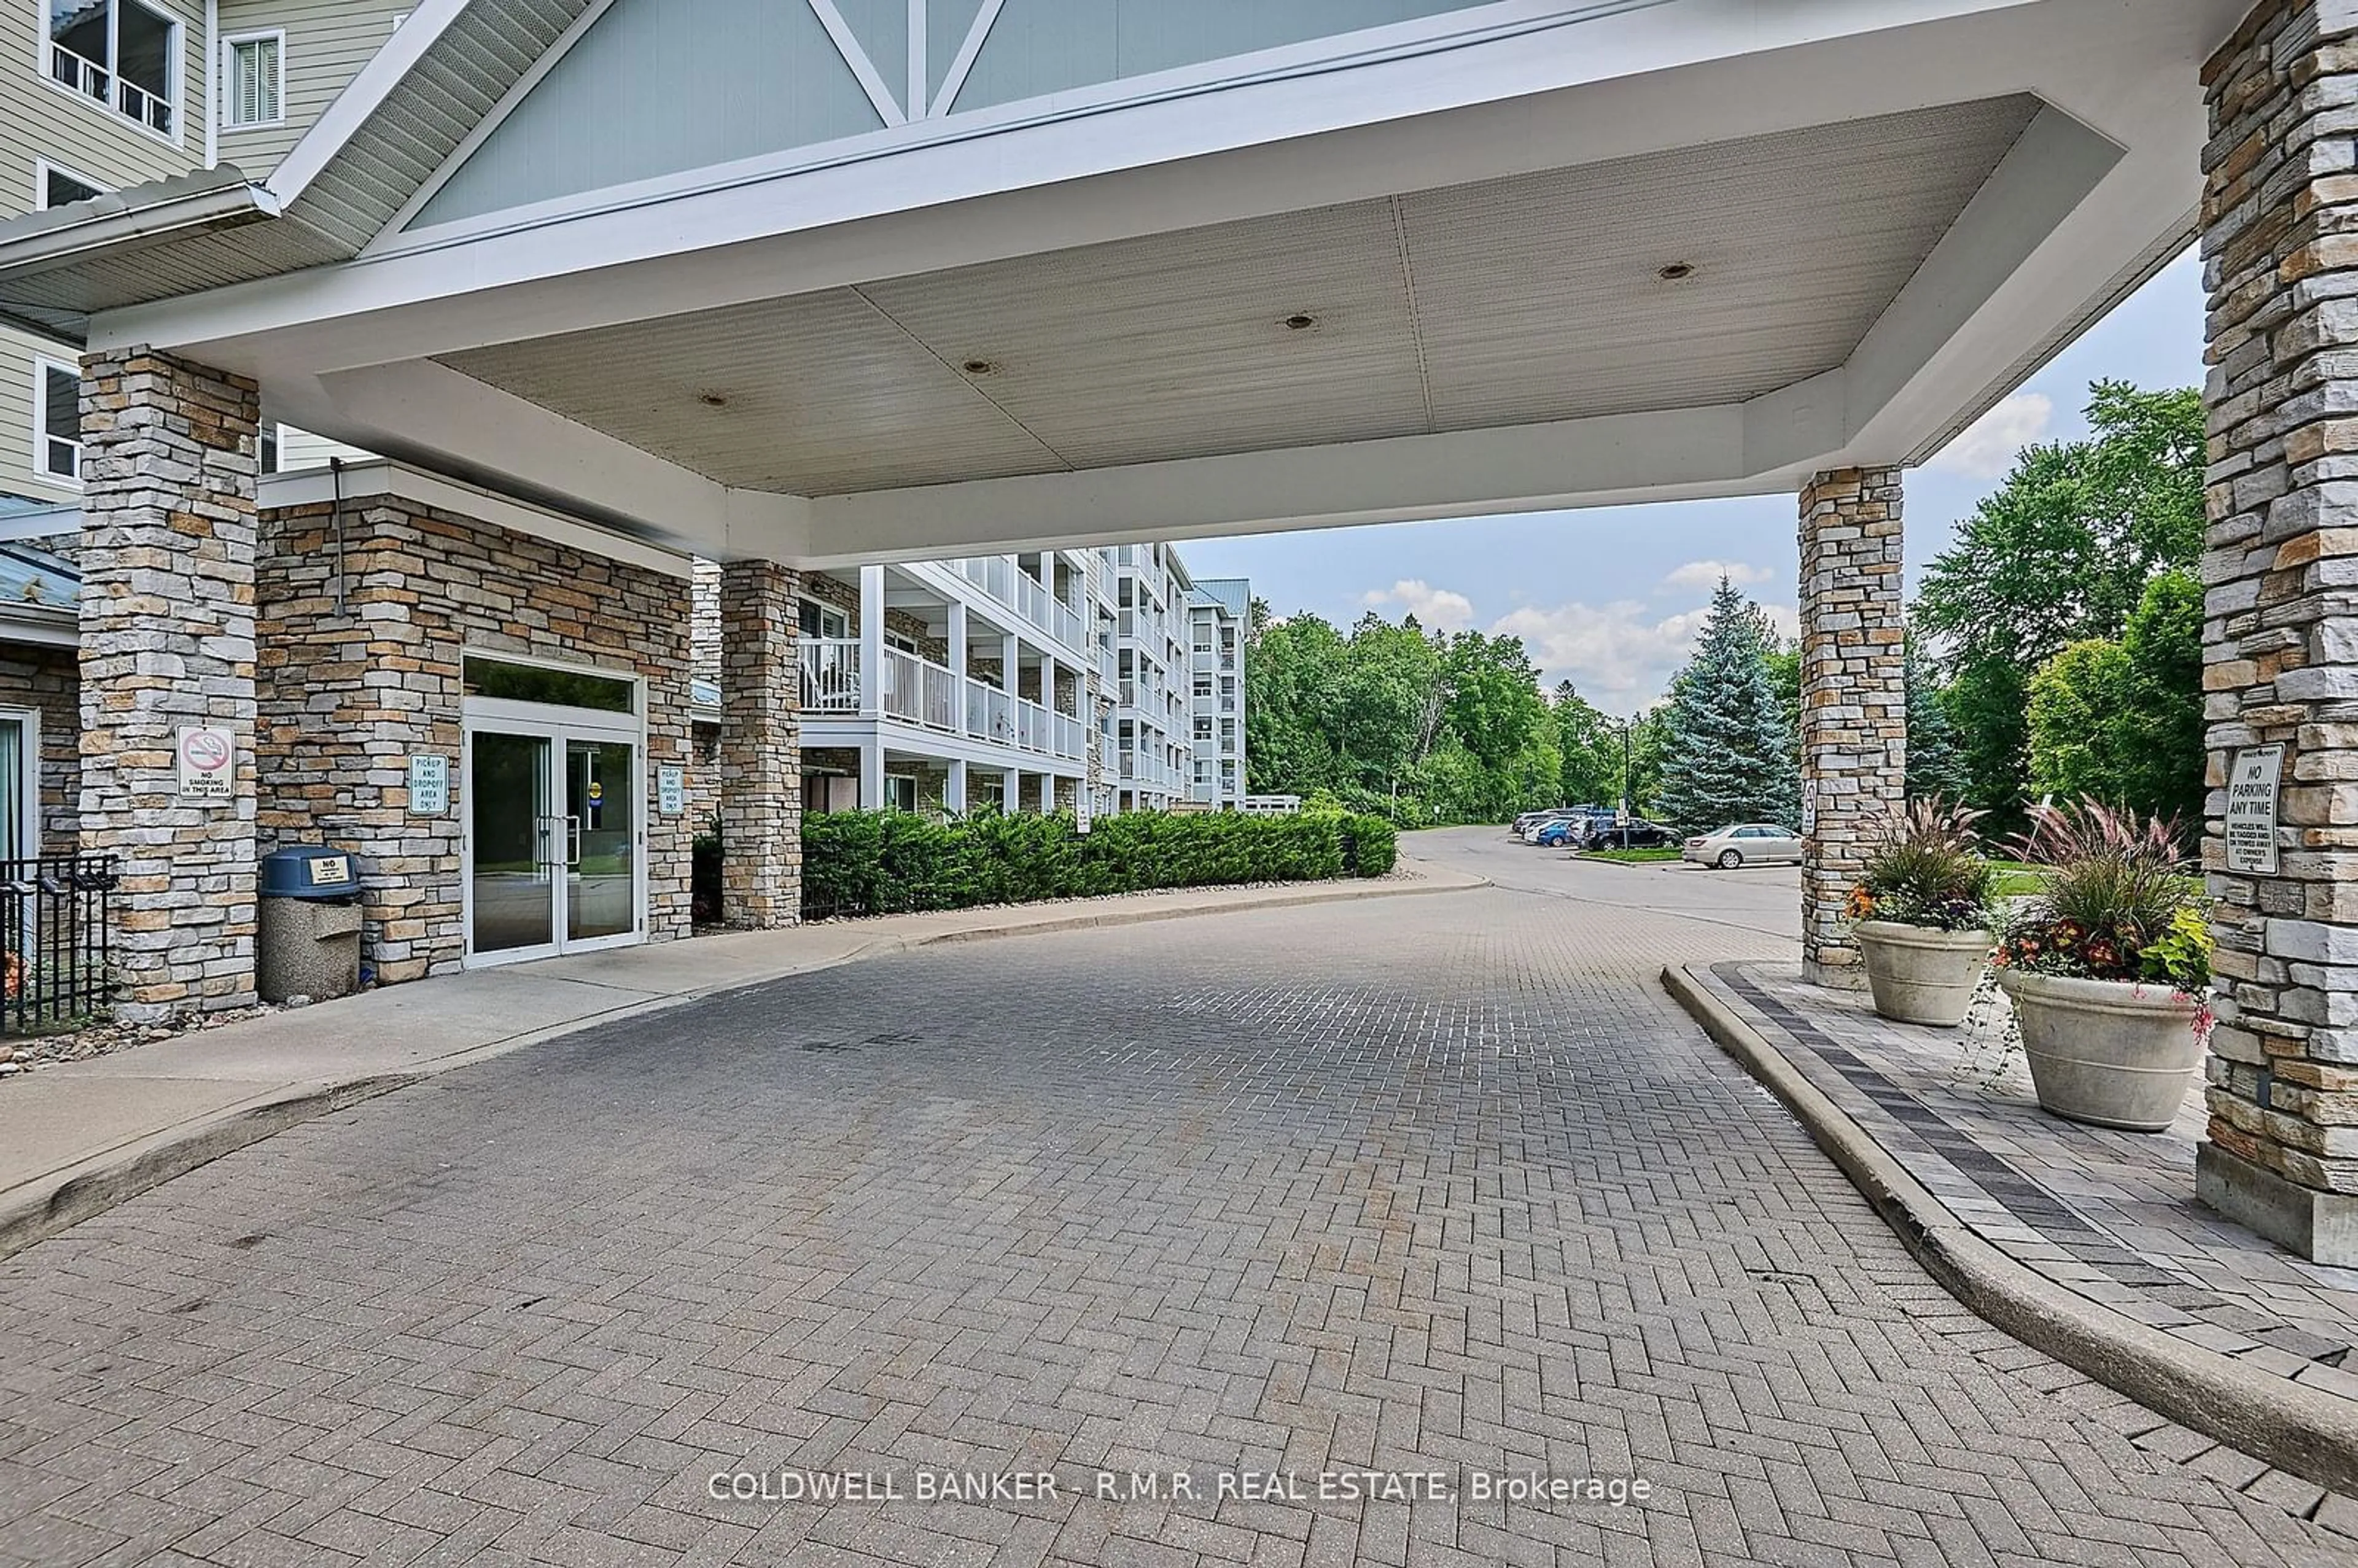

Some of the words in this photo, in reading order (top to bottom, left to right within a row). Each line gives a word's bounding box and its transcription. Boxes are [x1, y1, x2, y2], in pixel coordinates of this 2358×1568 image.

[2248, 766, 2262, 780] NO
[2233, 783, 2271, 797] PARKING
[421, 800, 437, 809] ONLY
[2230, 801, 2246, 814] ANY
[2249, 801, 2271, 815] TIME
